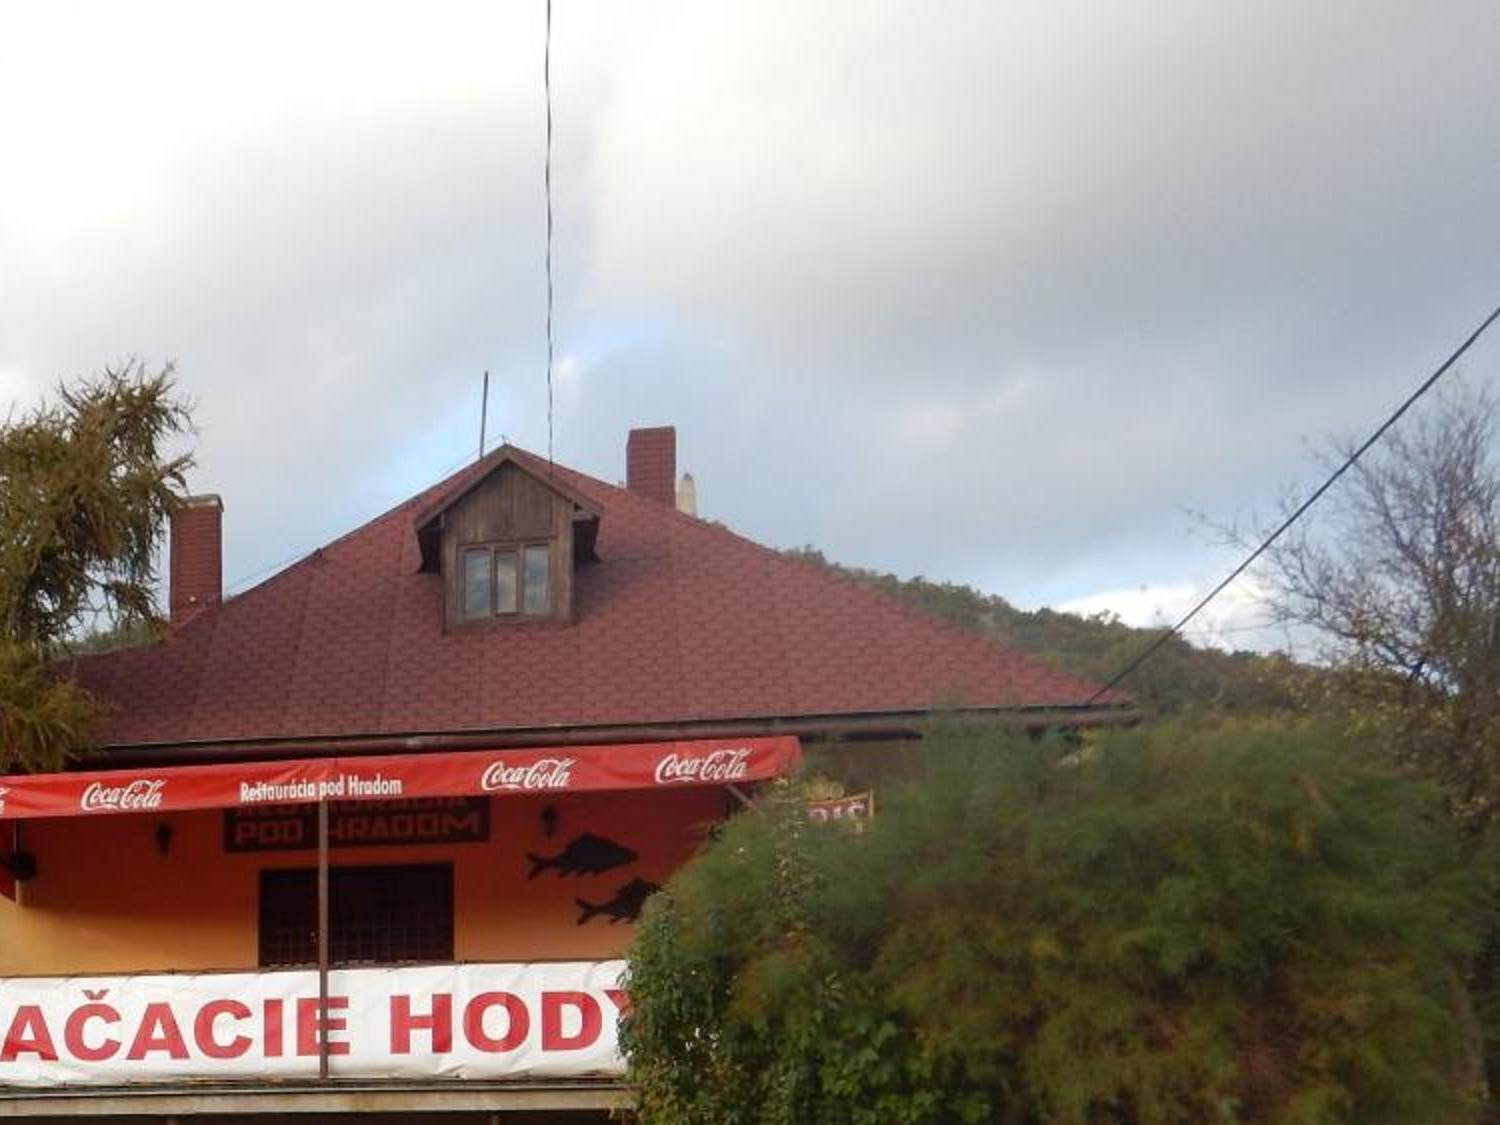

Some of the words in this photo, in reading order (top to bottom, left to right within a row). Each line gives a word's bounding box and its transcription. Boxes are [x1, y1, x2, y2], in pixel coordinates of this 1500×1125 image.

[482, 758, 577, 790] Coca-Cola
[656, 748, 752, 783] Coca-Cola
[81, 779, 166, 810] Coca-Cola
[319, 774, 344, 799] pod
[348, 773, 402, 796] Hradom
[235, 819, 303, 844] POD
